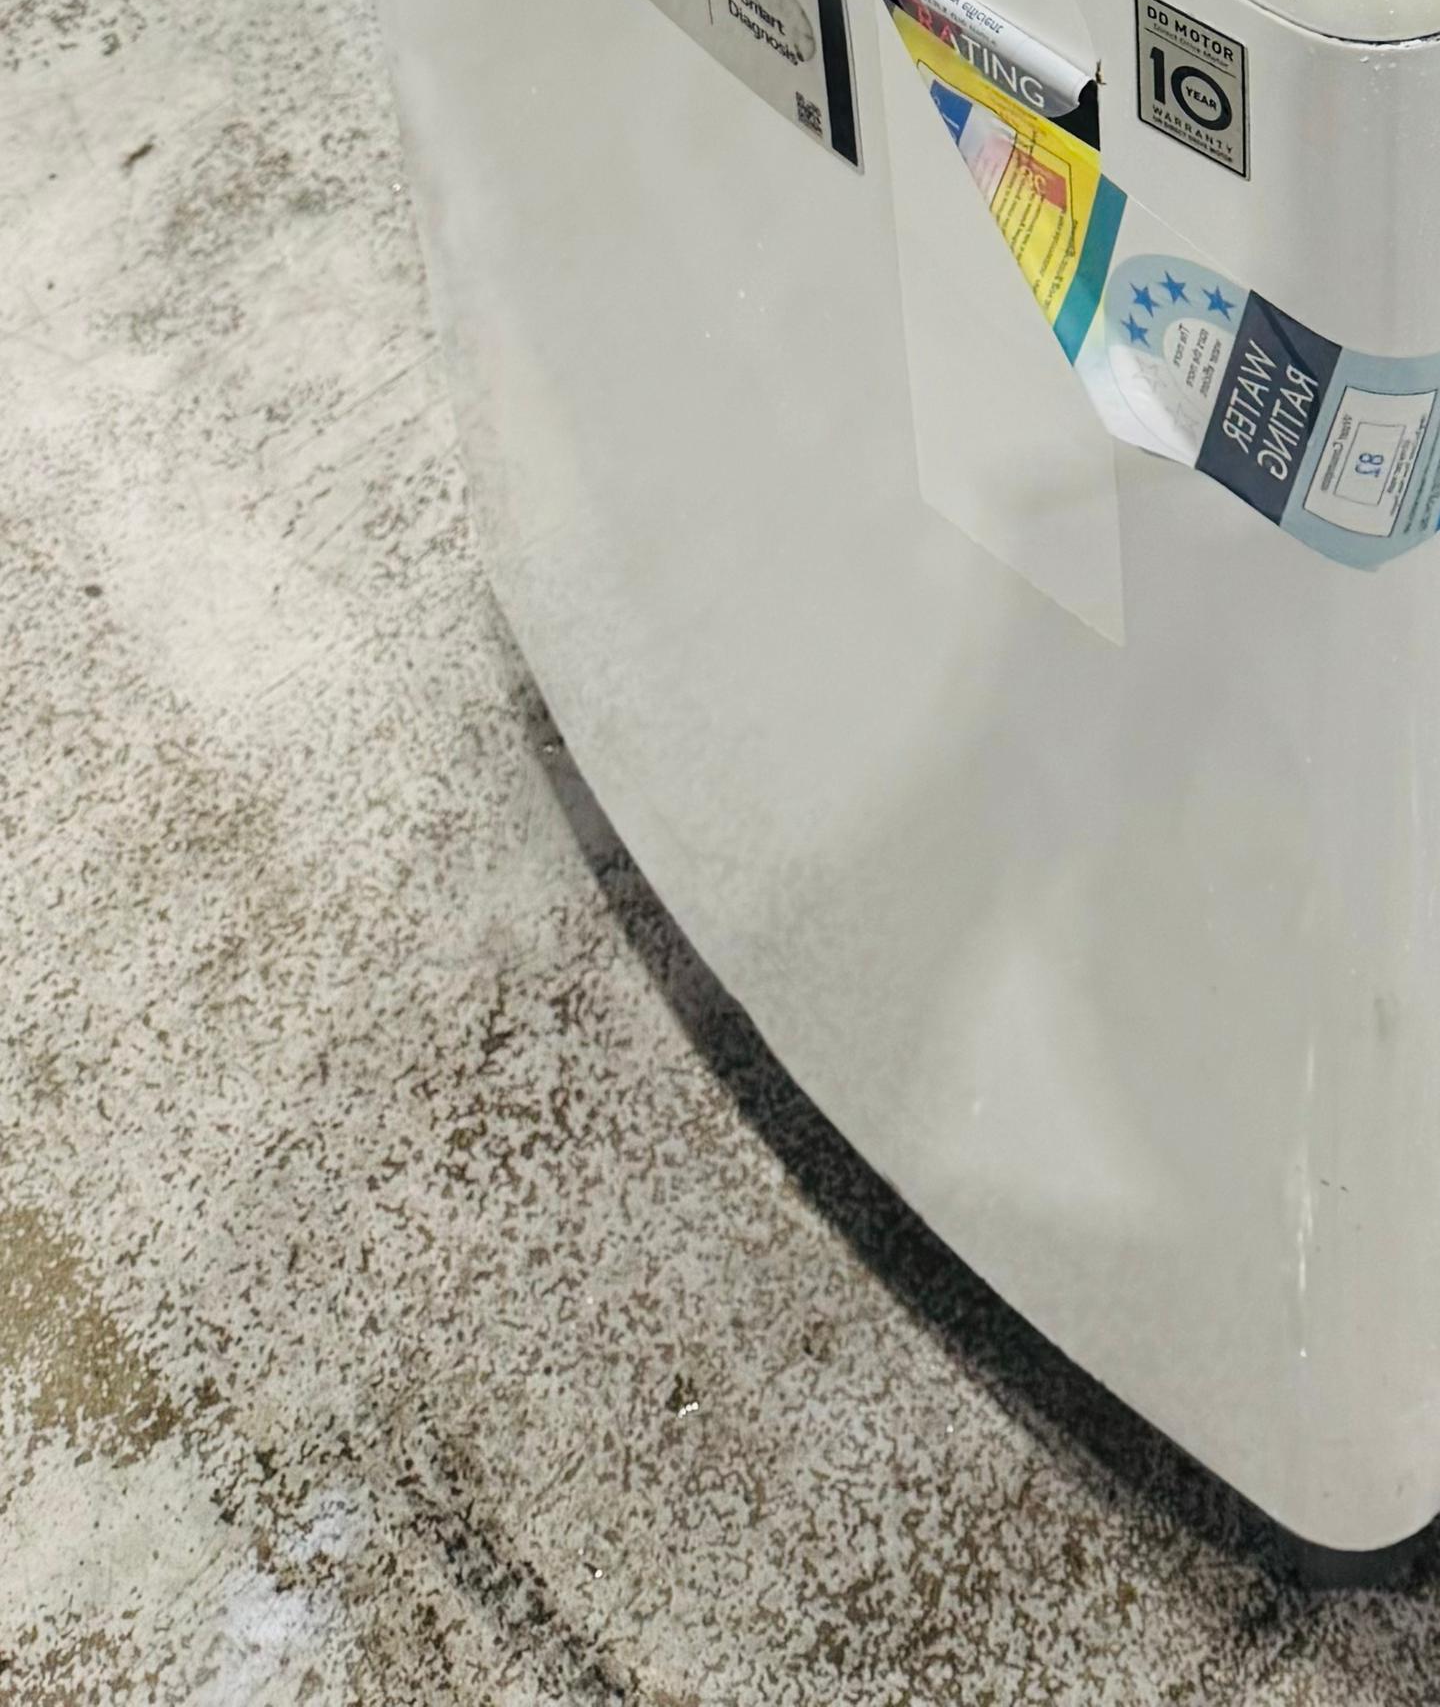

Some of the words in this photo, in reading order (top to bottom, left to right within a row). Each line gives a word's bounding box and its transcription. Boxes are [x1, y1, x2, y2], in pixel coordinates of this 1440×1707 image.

[916, 5, 1045, 109] RATING
[1147, 5, 1169, 26] DD
[1174, 19, 1234, 63] MOTOR
[1150, 45, 1233, 132] 10
[1185, 85, 1218, 112] YEAR
[1152, 103, 1234, 155] WARRANTY
